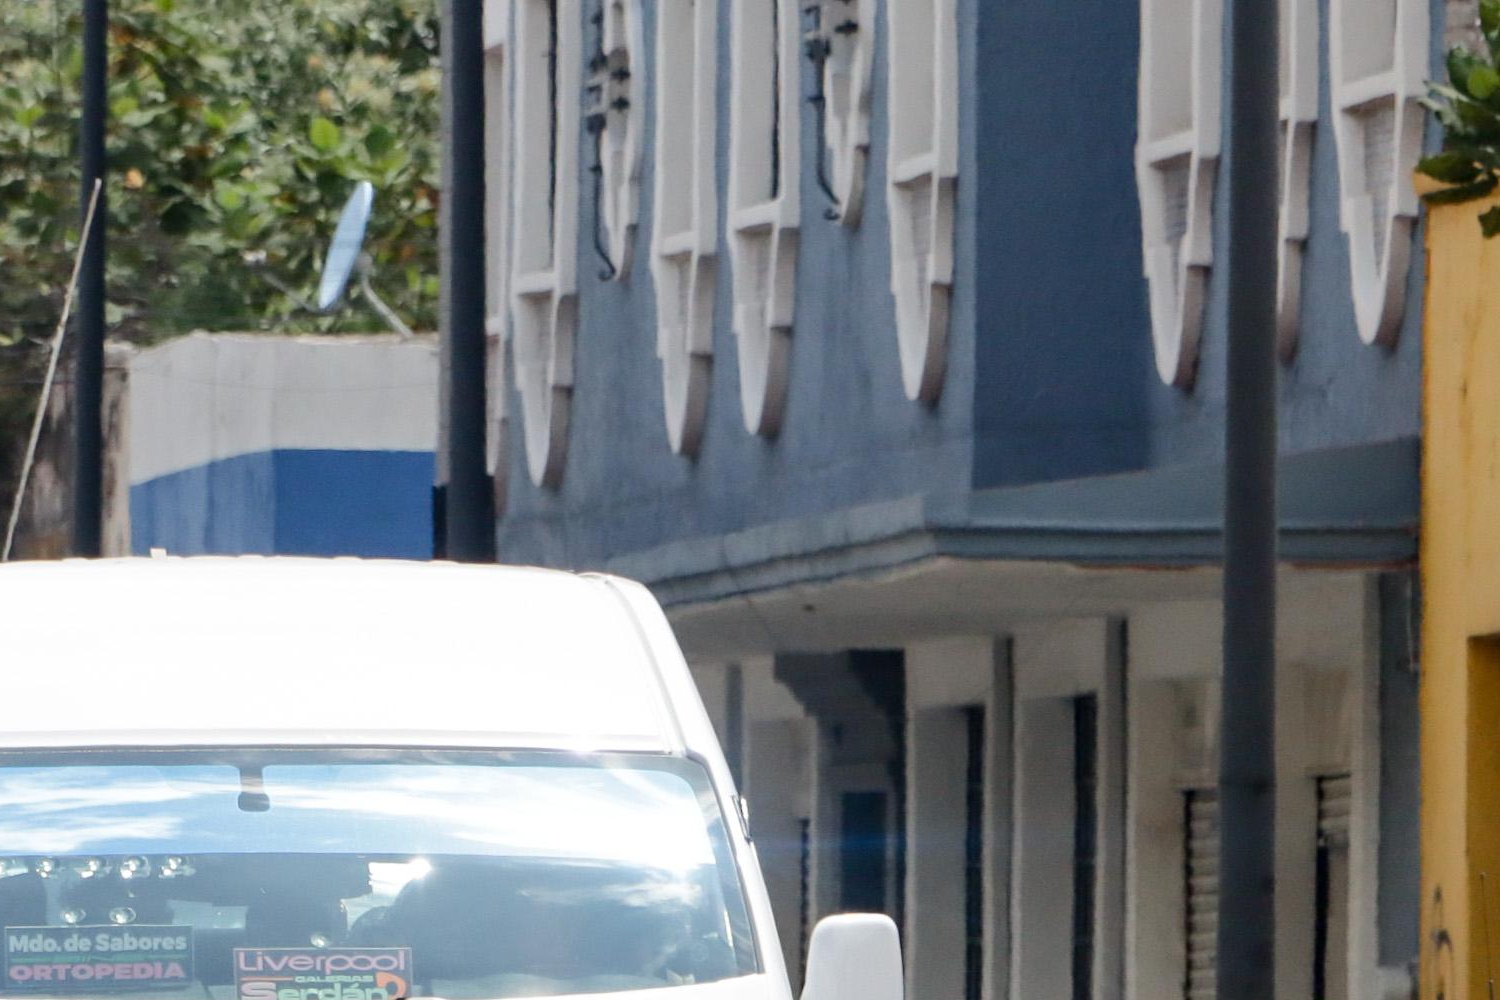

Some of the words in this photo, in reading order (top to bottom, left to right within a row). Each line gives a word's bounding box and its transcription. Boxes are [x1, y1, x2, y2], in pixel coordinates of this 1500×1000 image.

[65, 934, 91, 952] de
[94, 933, 187, 951] Sabores
[9, 962, 186, 981] ORTOPEDIA
[239, 949, 405, 975] Liverpool
[294, 975, 374, 983] GALERIAS
